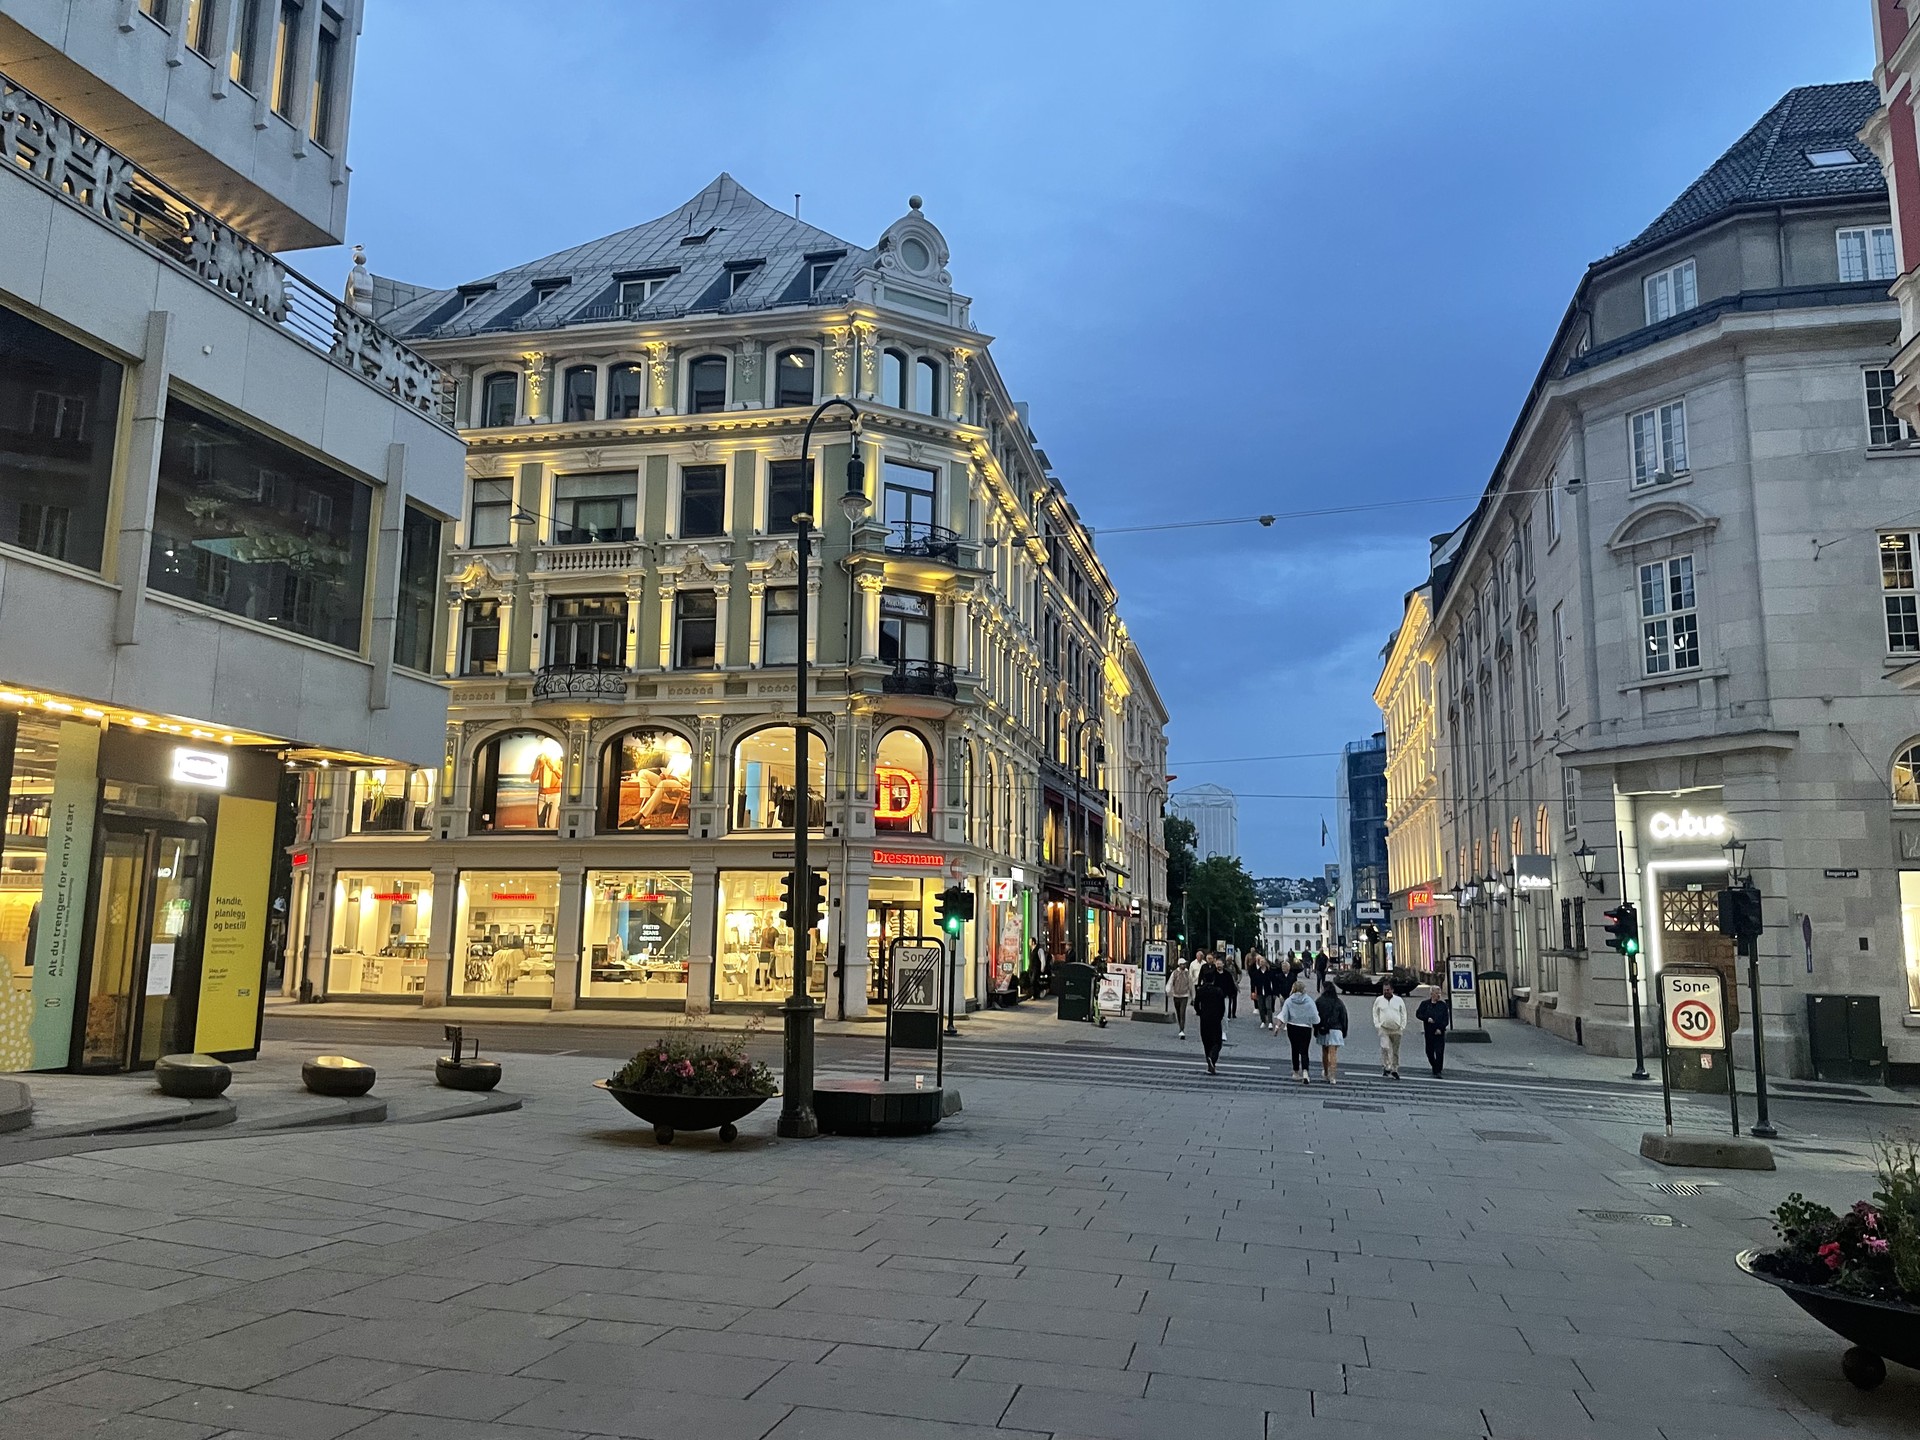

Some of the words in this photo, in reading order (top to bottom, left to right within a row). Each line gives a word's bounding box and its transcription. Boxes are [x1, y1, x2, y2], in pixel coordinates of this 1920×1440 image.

[874, 767, 921, 818] D
[67, 803, 75, 832] start
[1649, 808, 1726, 839] Cubus
[64, 835, 72, 850] ny
[62, 853, 69, 868] en
[873, 850, 944, 866] Dressmann
[58, 871, 67, 887] for
[1519, 874, 1551, 887] Cubus
[216, 896, 243, 906] Handle,
[53, 891, 66, 937] trenger
[214, 909, 246, 920] planlegg
[213, 922, 223, 932] og
[224, 921, 247, 930] bestill
[51, 941, 60, 956] du
[1148, 945, 1163, 953] Sone
[48, 960, 58, 977] Alt
[1453, 961, 1470, 969] Sone
[1672, 979, 1711, 993] Sone
[1680, 1010, 1708, 1031] 30
